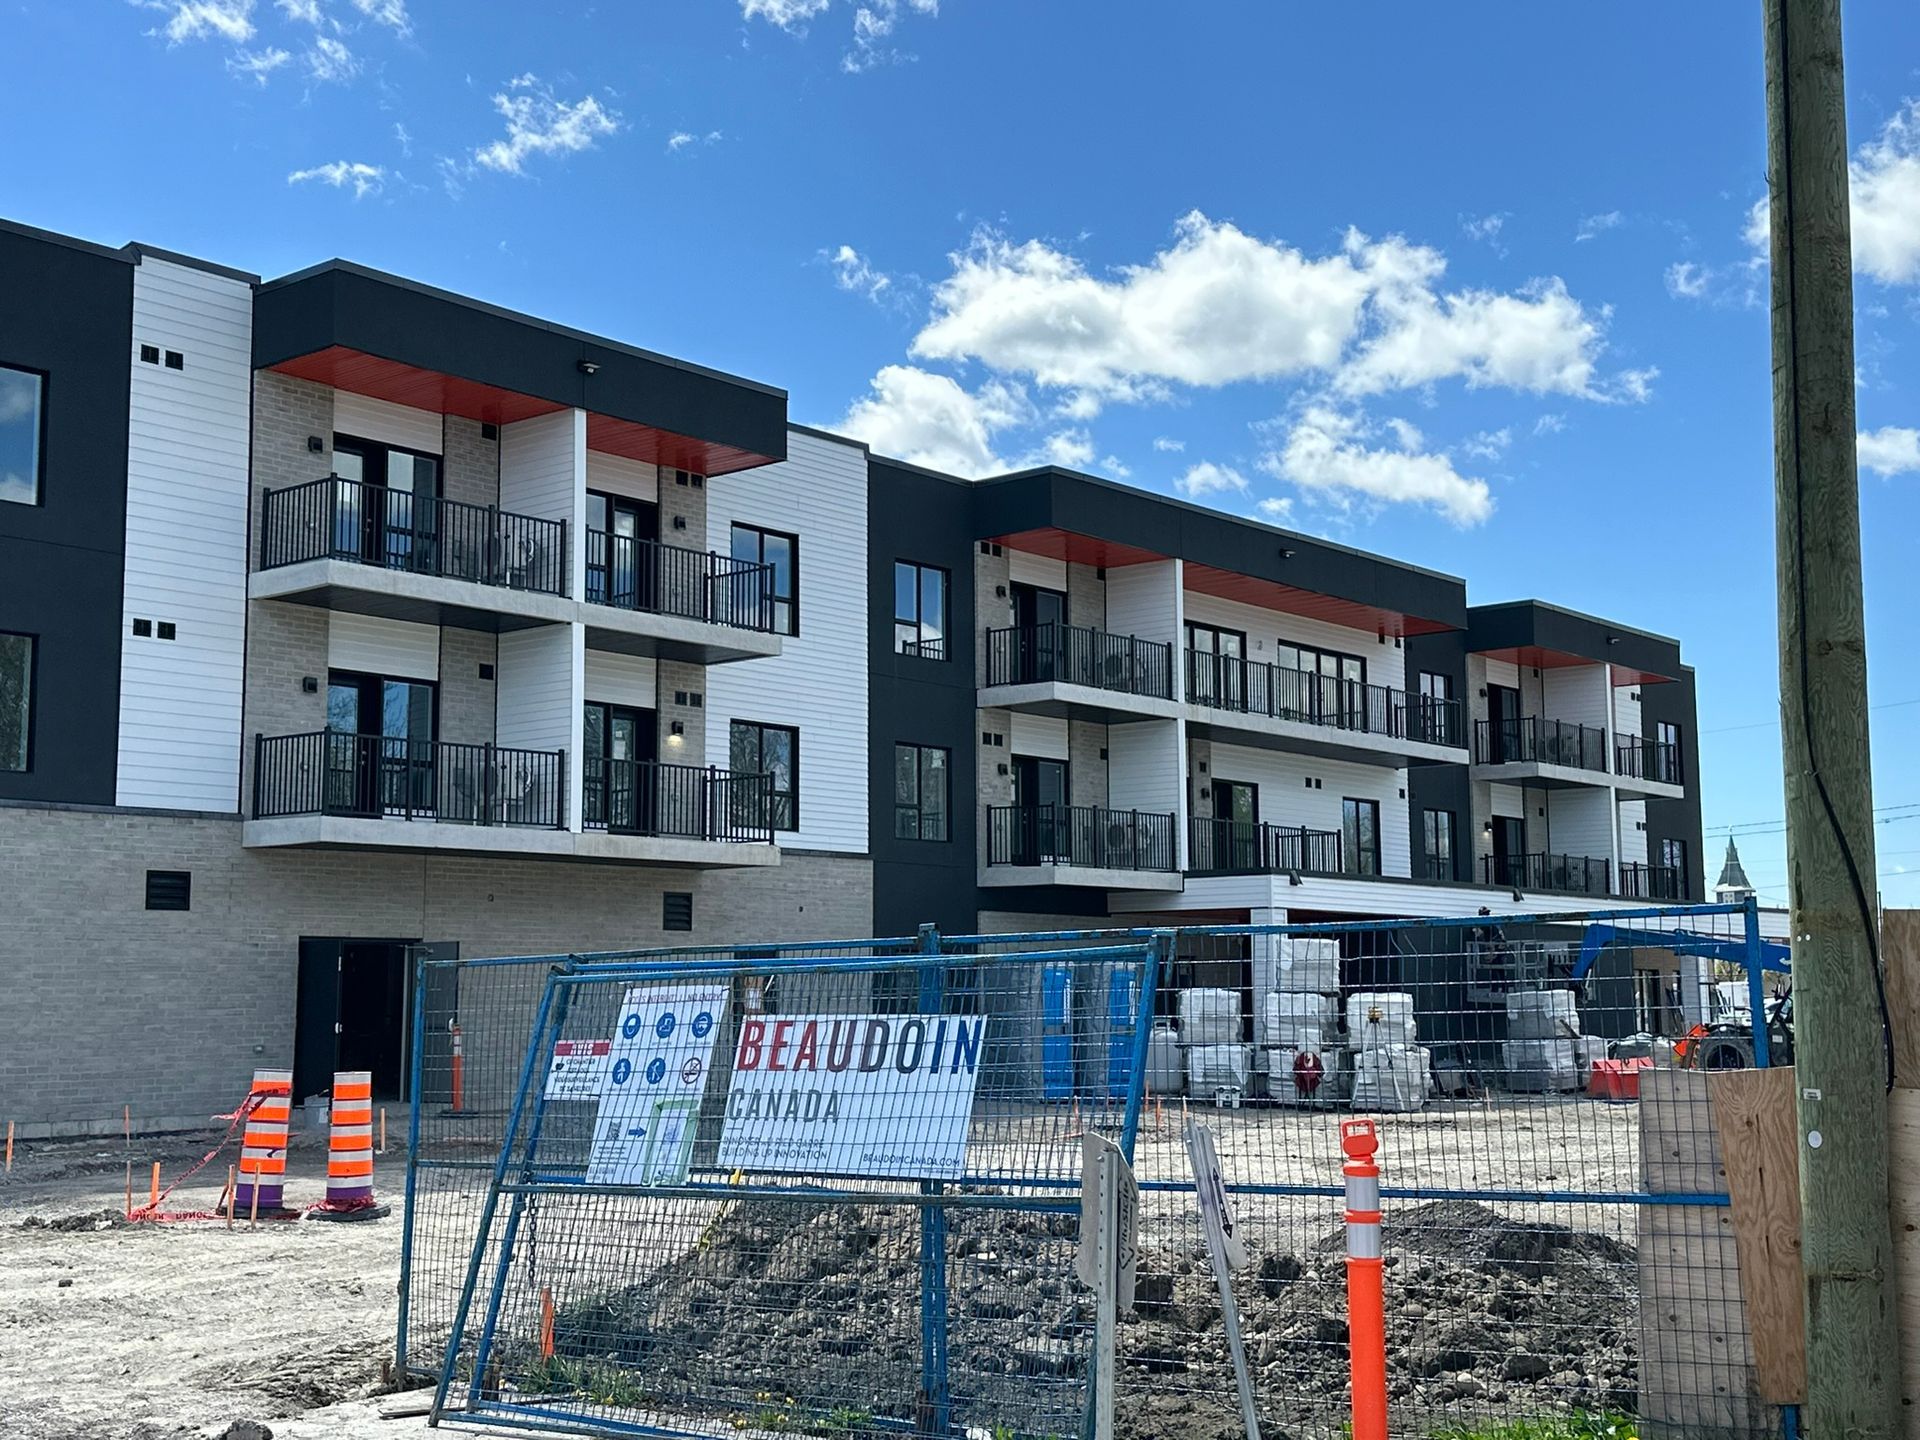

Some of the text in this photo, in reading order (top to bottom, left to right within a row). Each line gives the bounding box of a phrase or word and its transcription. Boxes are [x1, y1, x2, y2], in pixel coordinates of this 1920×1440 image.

[570, 1043, 594, 1055] AVIS
[737, 1019, 982, 1075] BEAUDOIN
[728, 1088, 839, 1124] CANADA
[722, 1147, 828, 1160] BUILDING UP INNOVATION
[863, 1153, 960, 1167] BEAUDOINCANADA.COM
